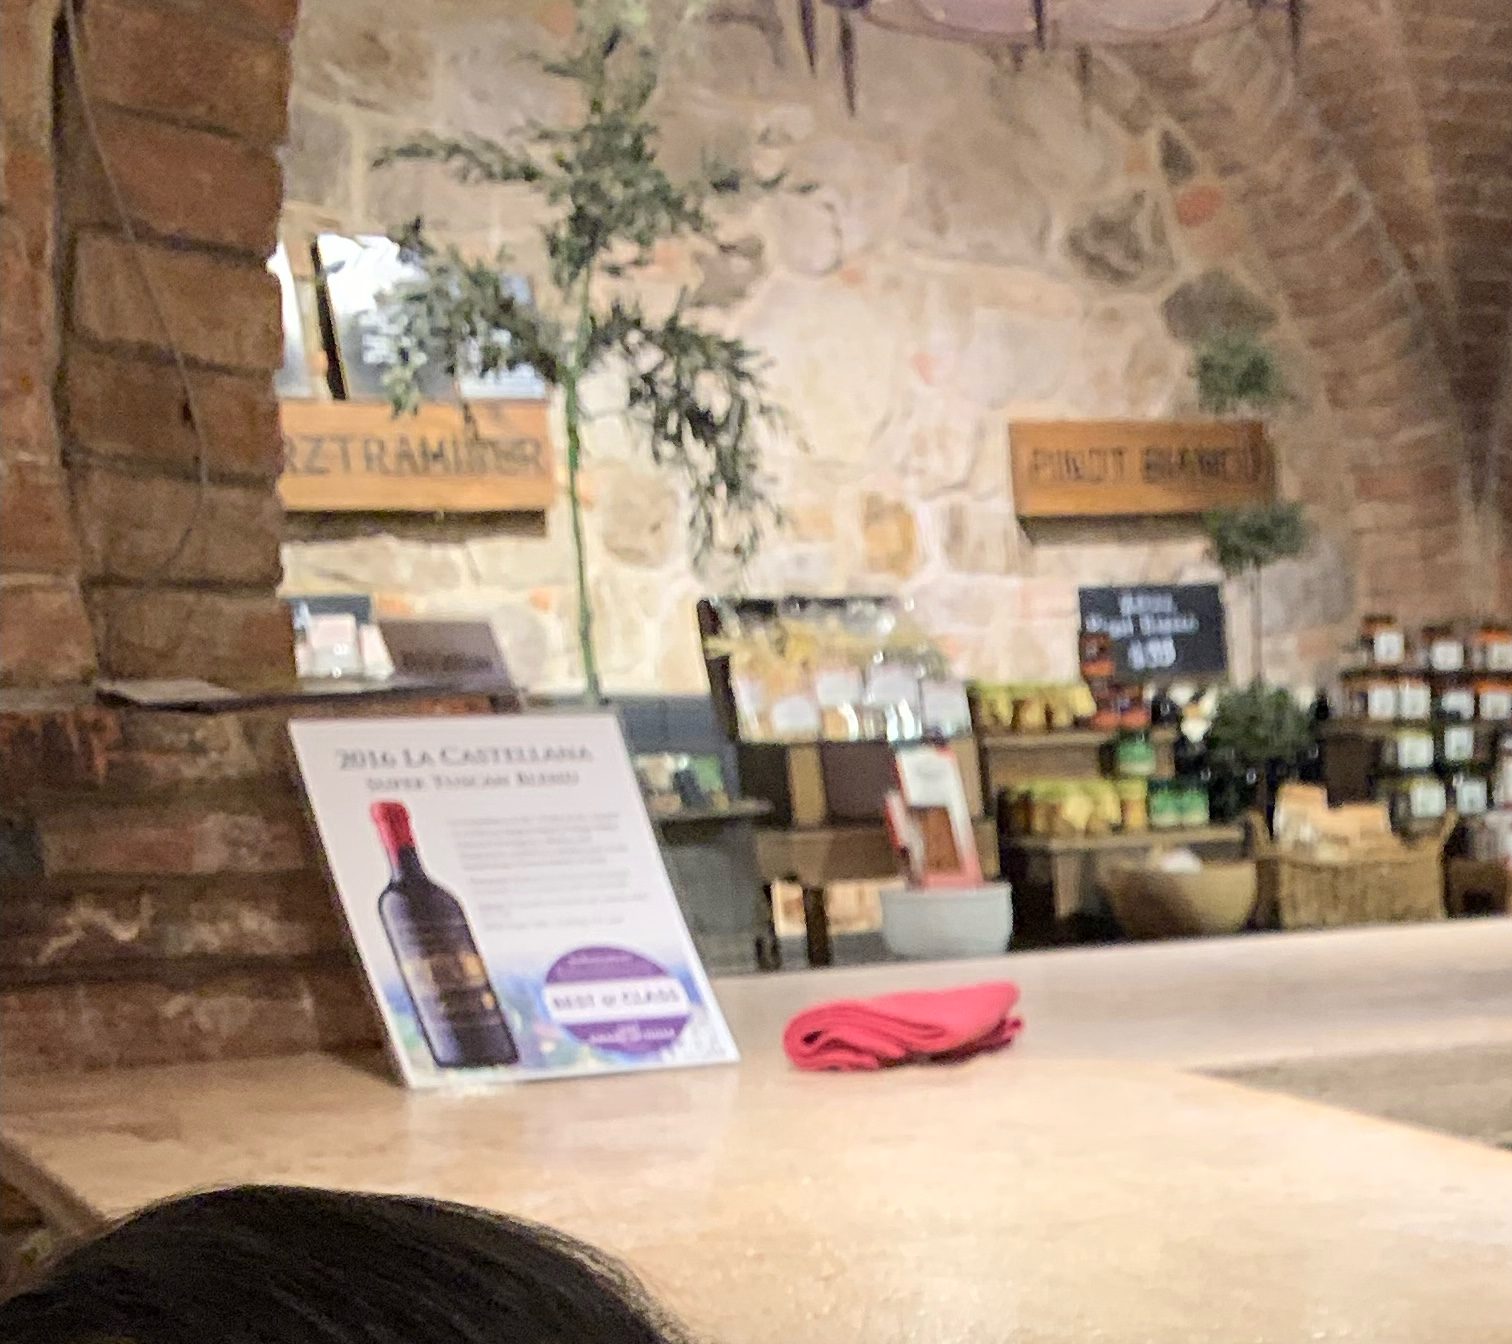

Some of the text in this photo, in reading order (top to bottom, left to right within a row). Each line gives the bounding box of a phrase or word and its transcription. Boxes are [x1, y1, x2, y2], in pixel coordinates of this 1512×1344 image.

[340, 744, 594, 771] 2016 LA CASTELLANA
[623, 989, 680, 1004] CLASS
